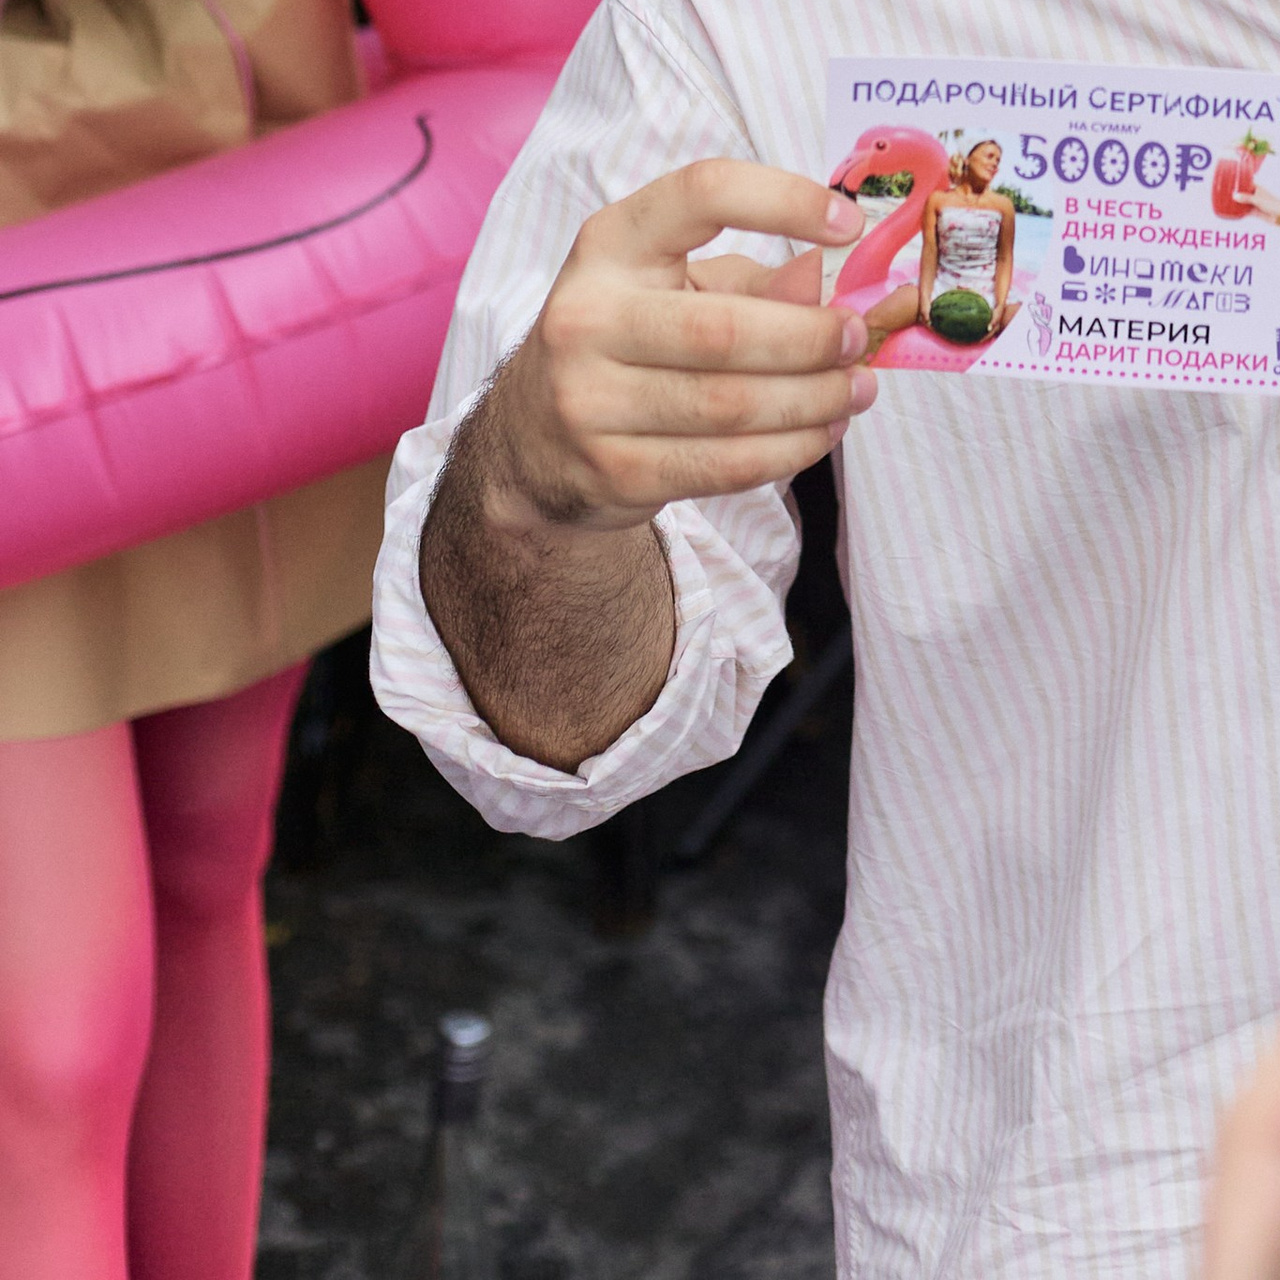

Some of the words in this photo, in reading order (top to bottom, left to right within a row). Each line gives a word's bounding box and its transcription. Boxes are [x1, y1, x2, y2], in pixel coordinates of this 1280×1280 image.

[853, 79, 1077, 109] ПОДАРОЧНЫЙ
[1069, 121, 1087, 132] НА
[1091, 123, 1141, 135] СУММУ
[1065, 197, 1079, 214] В
[1087, 199, 1162, 220] ЧЕСТЬ
[1062, 220, 1115, 241] ДНЯ
[1123, 225, 1266, 251] РОЖДЕНИЯ
[1059, 314, 1210, 345] МАТЕРИЯ
[1056, 342, 1140, 364] ДАРИТ
